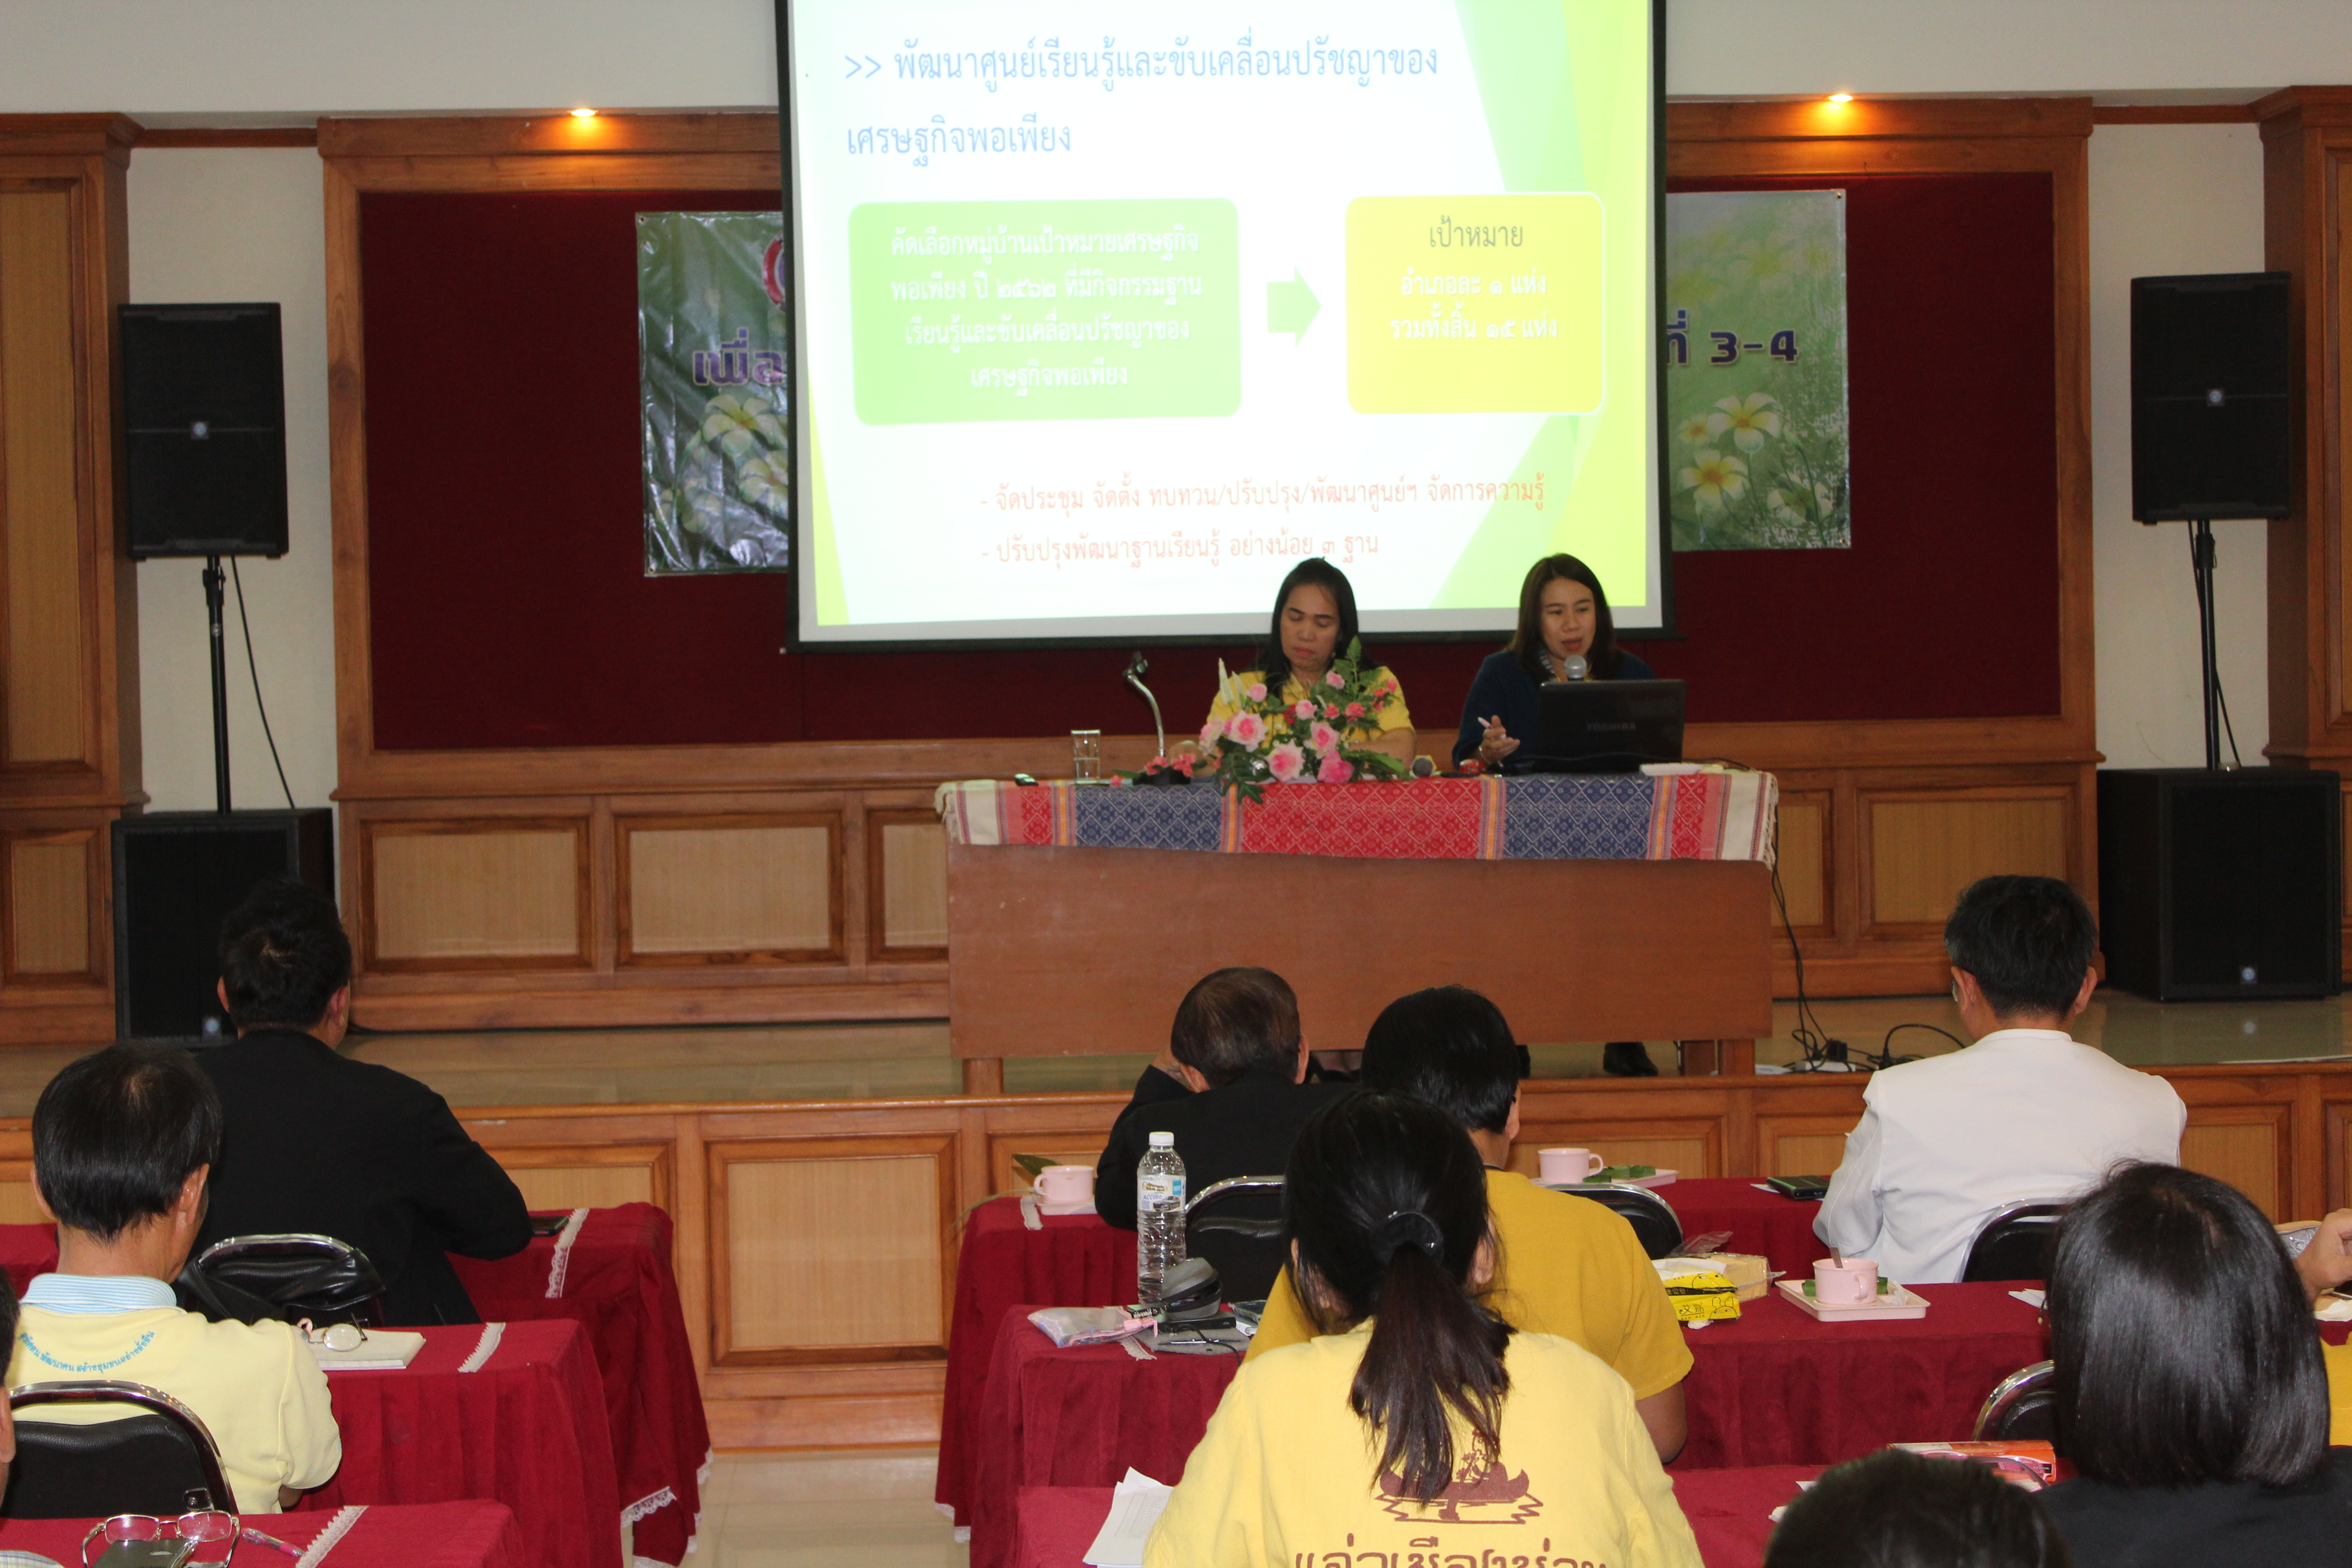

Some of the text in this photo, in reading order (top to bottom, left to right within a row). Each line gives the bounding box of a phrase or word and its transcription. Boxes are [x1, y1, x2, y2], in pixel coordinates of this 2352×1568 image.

[894, 26, 1437, 93] พัฒนาศูนย์เรียนรู้และขับเคลื่อนปรัชญาของ
[847, 112, 1071, 167] เศรษฐกิจพอเพียง
[891, 223, 1199, 264] คัดเลือกหมู่บ้านเป้าหมายเศรษฐกิจ
[1430, 215, 1523, 248] เป้าหมาย
[890, 262, 1202, 306] พอเพียง ปี ๒๕๖๒ ที่มีกิจกรรมฐาน
[1400, 266, 1547, 296] อำเภอละ ๑ แห่ง
[905, 307, 1190, 354] เรียนรู้และขับเคลื่อนปรัชญาของ
[1389, 300, 1558, 340] รวมทั้งสิ้น ๑๕ แห่ง
[1710, 330, 1798, 363] 3-4
[971, 357, 1128, 397] เศรษฐกิจพอเพียง
[996, 483, 1083, 519] จัดประชุม
[1093, 471, 1140, 509] จัดตั้ง
[1148, 474, 1417, 513] ทบทวน/ปรับปรุง/พัฒนาศูนย์ฯ
[1427, 472, 1544, 510] จัดการความรู้
[996, 529, 1220, 570] ปรับปรุงพัฒนาฐานเรียนรู้
[1230, 527, 1313, 555] อย่างน้อย
[1342, 536, 1378, 564] ฐาน
